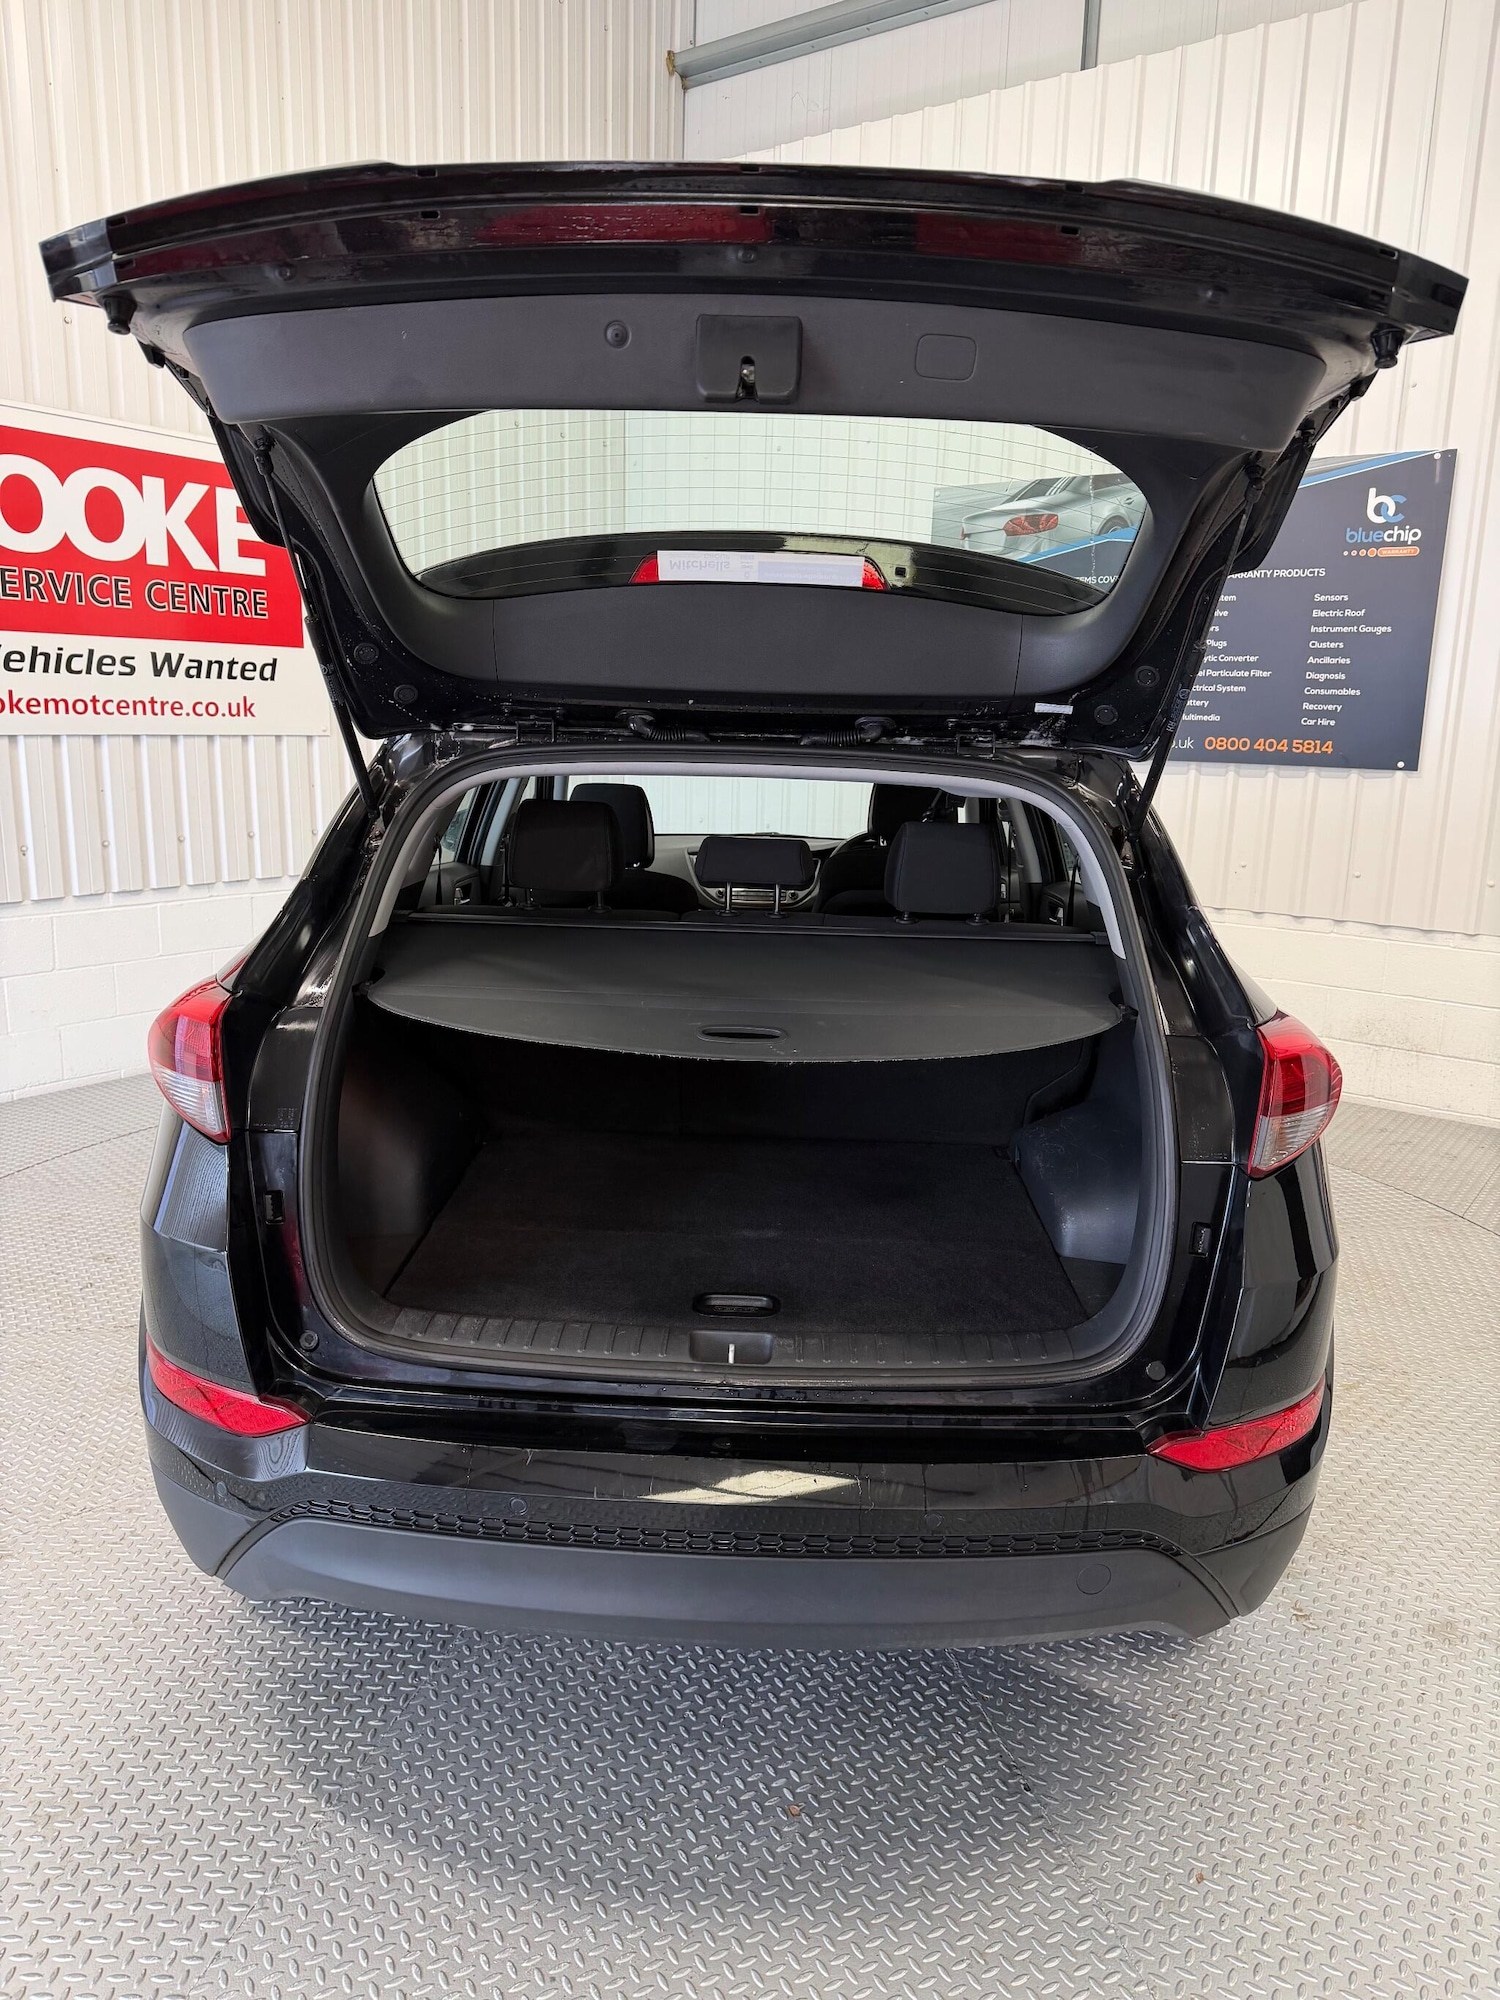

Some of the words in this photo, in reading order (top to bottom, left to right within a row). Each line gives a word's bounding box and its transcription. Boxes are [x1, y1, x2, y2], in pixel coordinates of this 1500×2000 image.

[1346, 525, 1422, 545] bluechip
[1273, 568, 1326, 578] PRODUCTS
[1097, 575, 1118, 584] COV
[0, 566, 133, 610] ERVICE
[145, 580, 269, 619] CENTRE
[1313, 593, 1349, 601] Sensors
[1312, 609, 1344, 618] Electric
[1344, 608, 1366, 617] Roof
[1310, 625, 1358, 633] Instrument
[1358, 624, 1392, 635] Gauges
[1308, 640, 1344, 649] Clusters
[0, 644, 136, 676] ehicles
[150, 651, 278, 682] Wanted
[1218, 654, 1259, 662] Converter
[1307, 656, 1351, 664] Ancillaries
[1206, 669, 1250, 677] Particulate
[1250, 669, 1273, 677] Filter
[1305, 671, 1346, 682] Diagnosis
[1216, 684, 1247, 694] System
[1304, 687, 1361, 696] Consumables
[1302, 702, 1343, 712] Recovery
[1301, 717, 1316, 726] Car
[1317, 718, 1336, 727] Hire
[1204, 736, 1250, 751] 0800
[1253, 738, 1289, 753] 404
[1292, 740, 1334, 755] 5814
